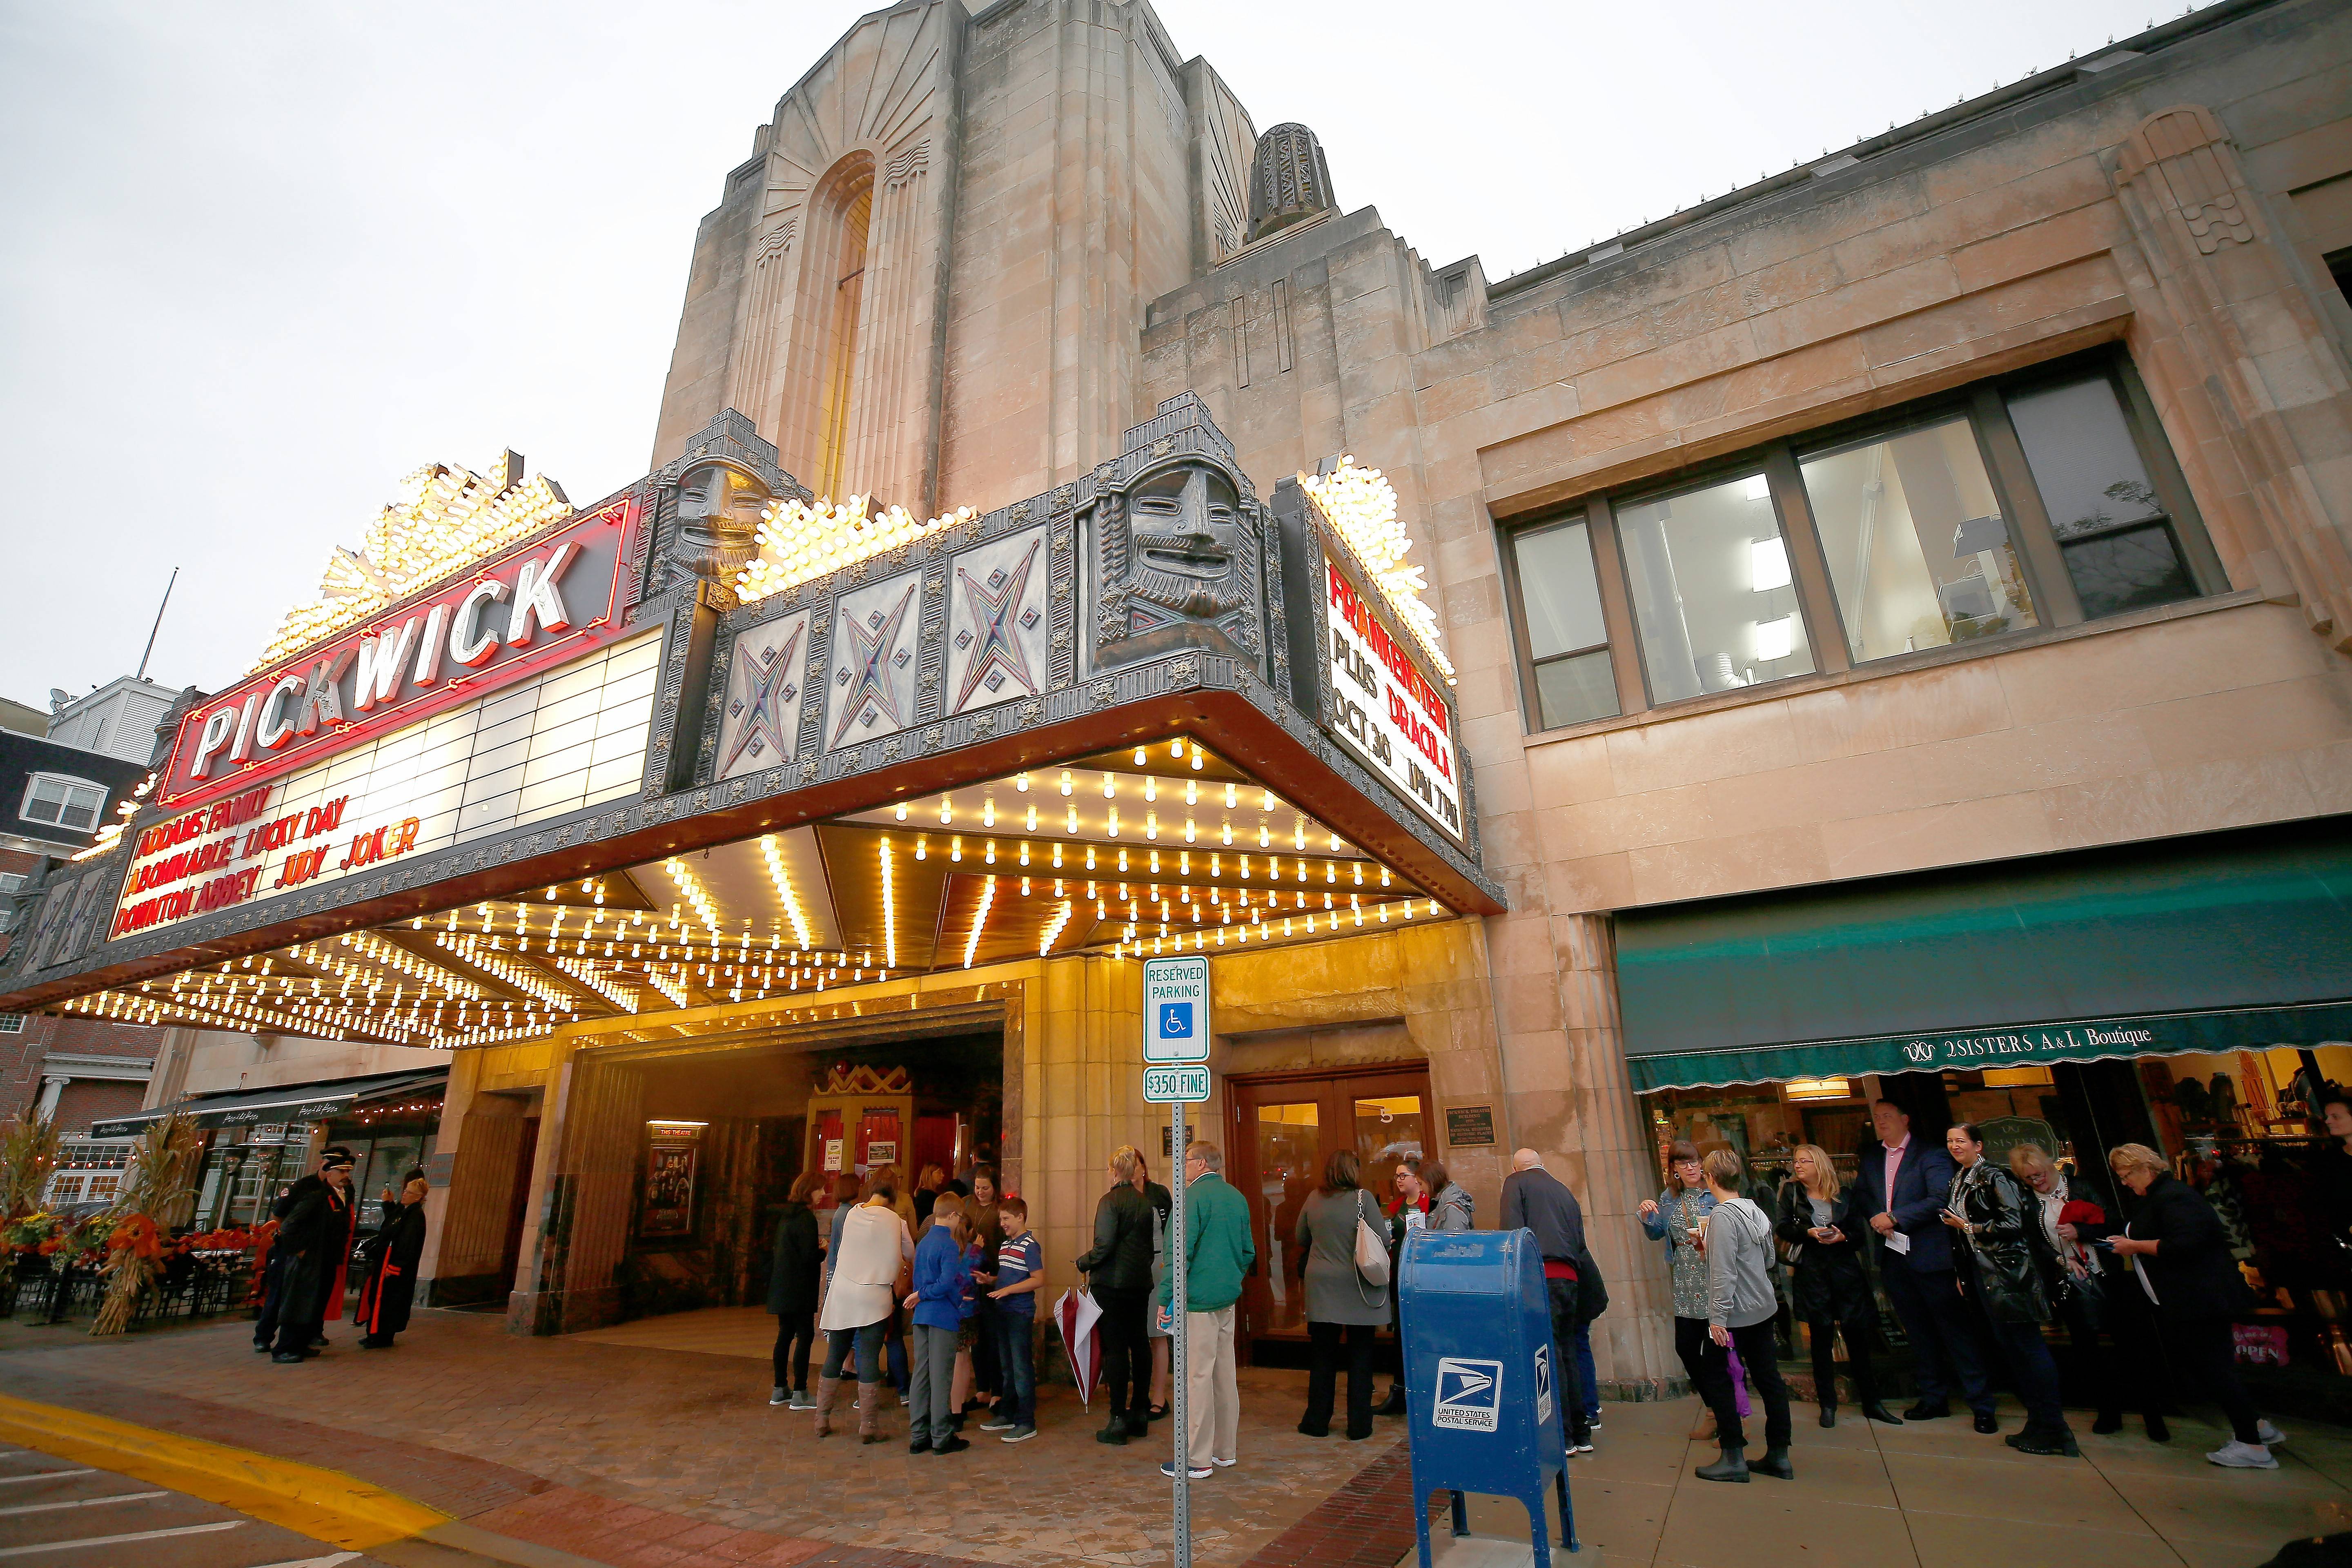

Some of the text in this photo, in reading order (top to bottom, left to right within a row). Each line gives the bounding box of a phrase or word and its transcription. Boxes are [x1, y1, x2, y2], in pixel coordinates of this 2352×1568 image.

[189, 540, 581, 780] PICKWICK
[1330, 564, 1449, 737] FRANKENSTEIN
[1334, 628, 1453, 785] PLUS DRACULA
[1332, 688, 1367, 747] OCT
[1372, 722, 1391, 767] 30
[135, 784, 273, 859] ADDAMS FAMILY
[124, 795, 349, 898] ABOMINABLE LUCKY DAY
[113, 817, 420, 938] DOWNTON ABBEY JUDY JOKER
[1149, 967, 1203, 982] RESERVED
[1152, 985, 1200, 999] PARKING
[1944, 1026, 2152, 1058] 2SISTERS A & L Boutique
[1148, 1074, 1205, 1094] $350 FINE
[1380, 1109, 1393, 1123] 5
[2236, 1345, 2278, 1359] OPEN
[1437, 1416, 1494, 1427] POSTAL SERVICE
[1438, 1408, 1465, 1417] UNITED
